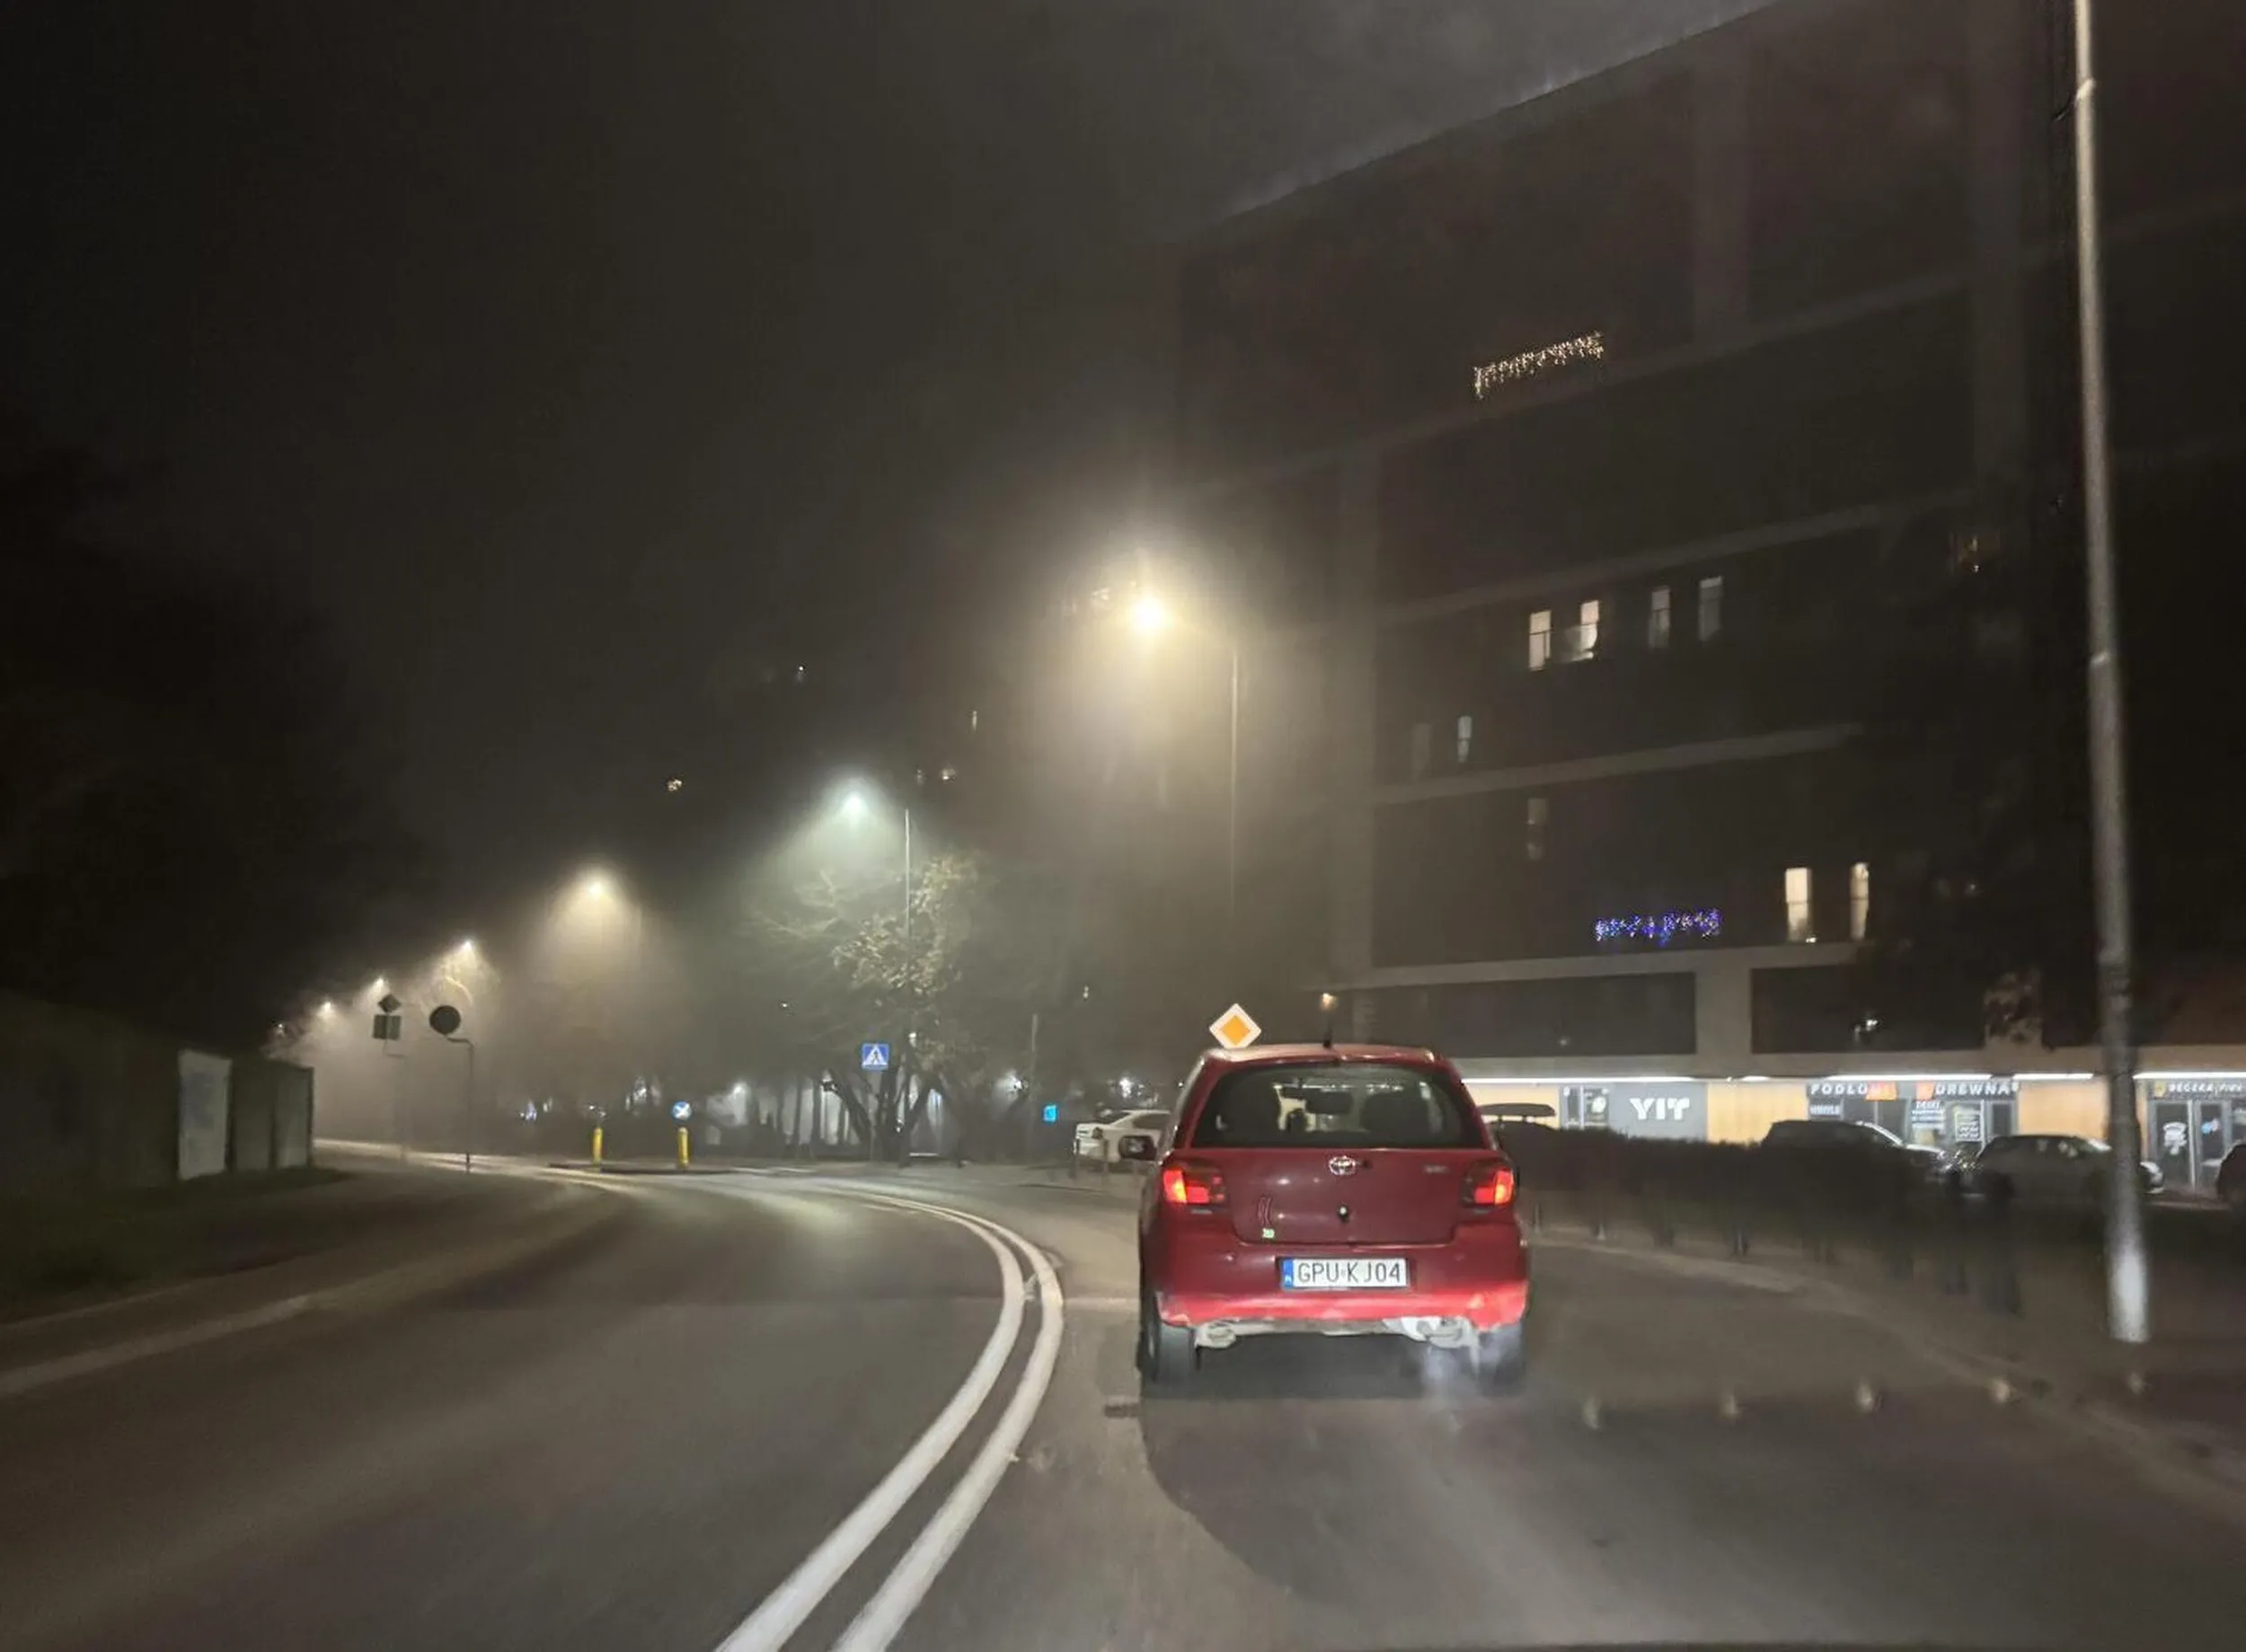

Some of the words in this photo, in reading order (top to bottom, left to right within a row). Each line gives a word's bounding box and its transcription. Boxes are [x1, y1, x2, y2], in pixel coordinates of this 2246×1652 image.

[1630, 1097, 1690, 1120] YIT
[1297, 1261, 1339, 1283] GPU
[1347, 1261, 1401, 1283] KJ04
